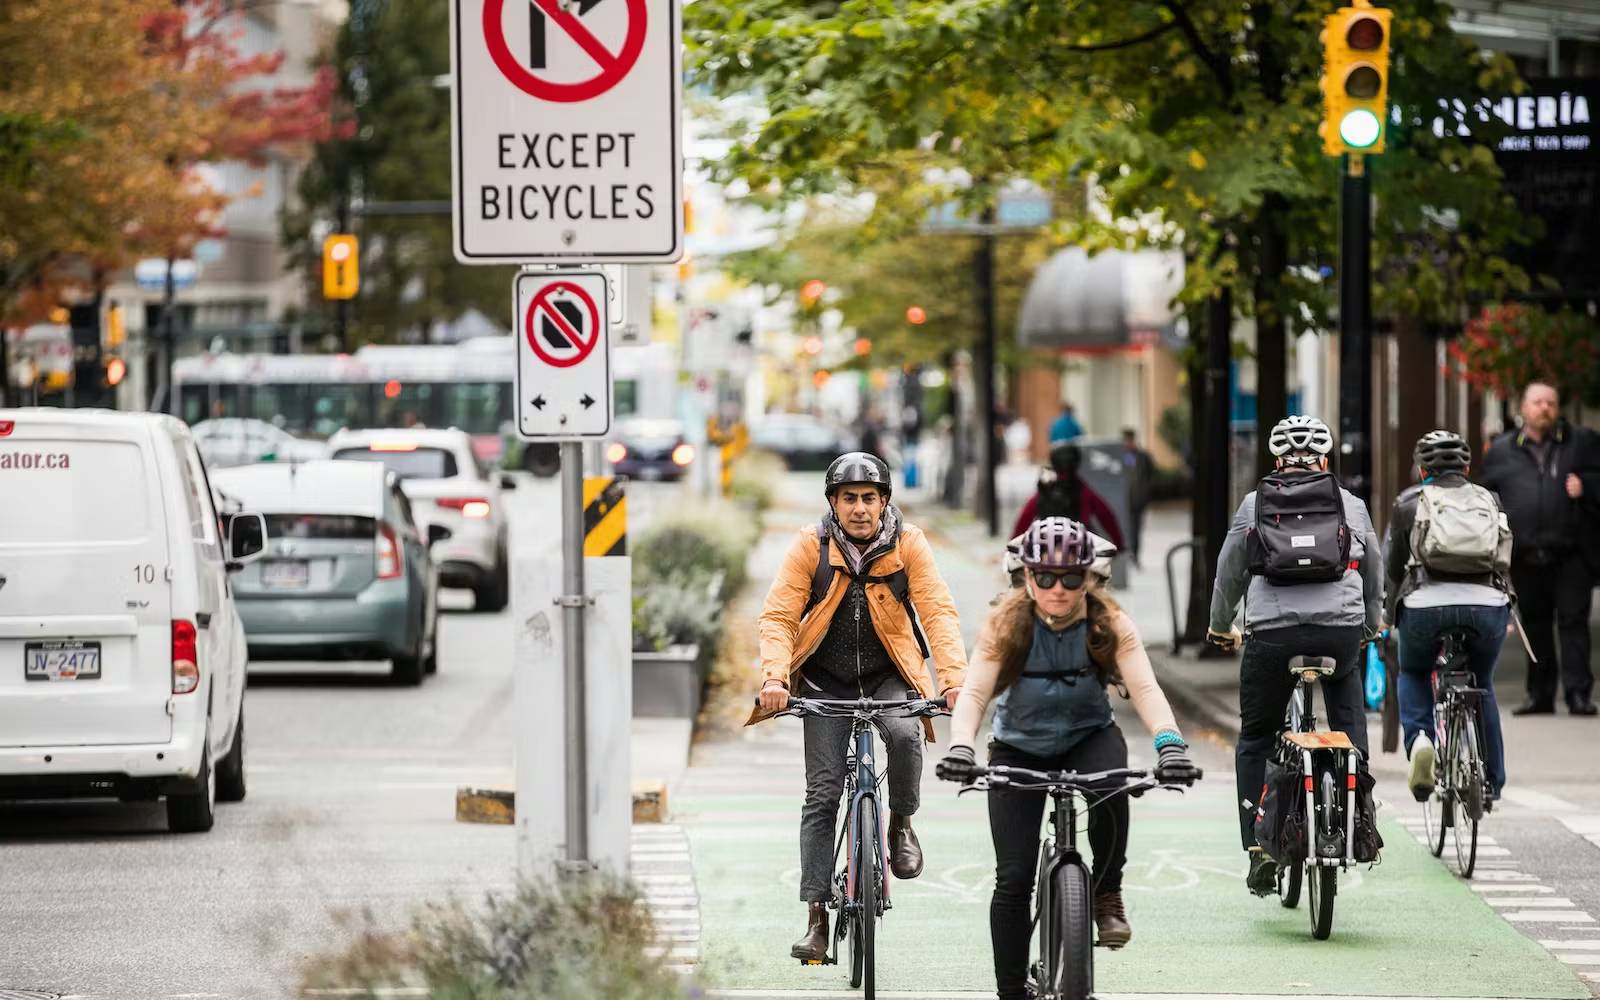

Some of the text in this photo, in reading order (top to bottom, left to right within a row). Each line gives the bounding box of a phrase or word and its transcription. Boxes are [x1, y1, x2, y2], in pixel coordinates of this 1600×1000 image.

[498, 133, 636, 169] EXCEPT
[481, 184, 655, 220] BICYCLES
[0, 452, 71, 469] ator.ca
[29, 652, 97, 671] JV-2477
